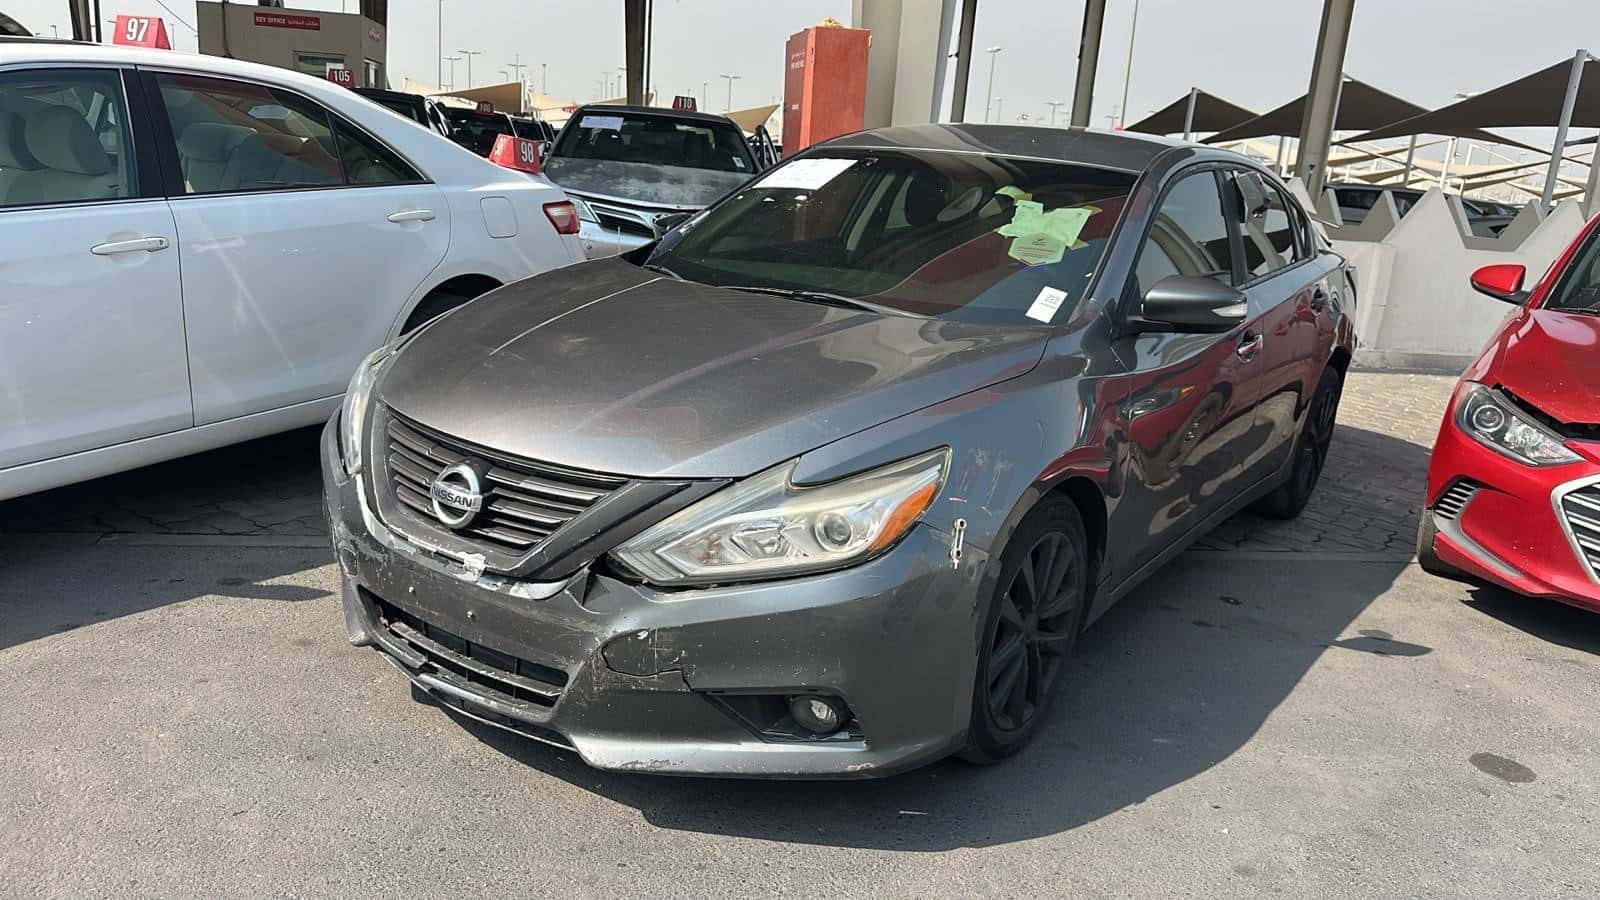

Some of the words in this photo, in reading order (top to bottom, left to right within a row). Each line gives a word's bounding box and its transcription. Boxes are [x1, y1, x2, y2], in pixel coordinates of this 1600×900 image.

[126, 18, 148, 41] 97
[334, 70, 350, 82] 105
[521, 142, 534, 163] 98
[431, 486, 473, 508] NISSAN
